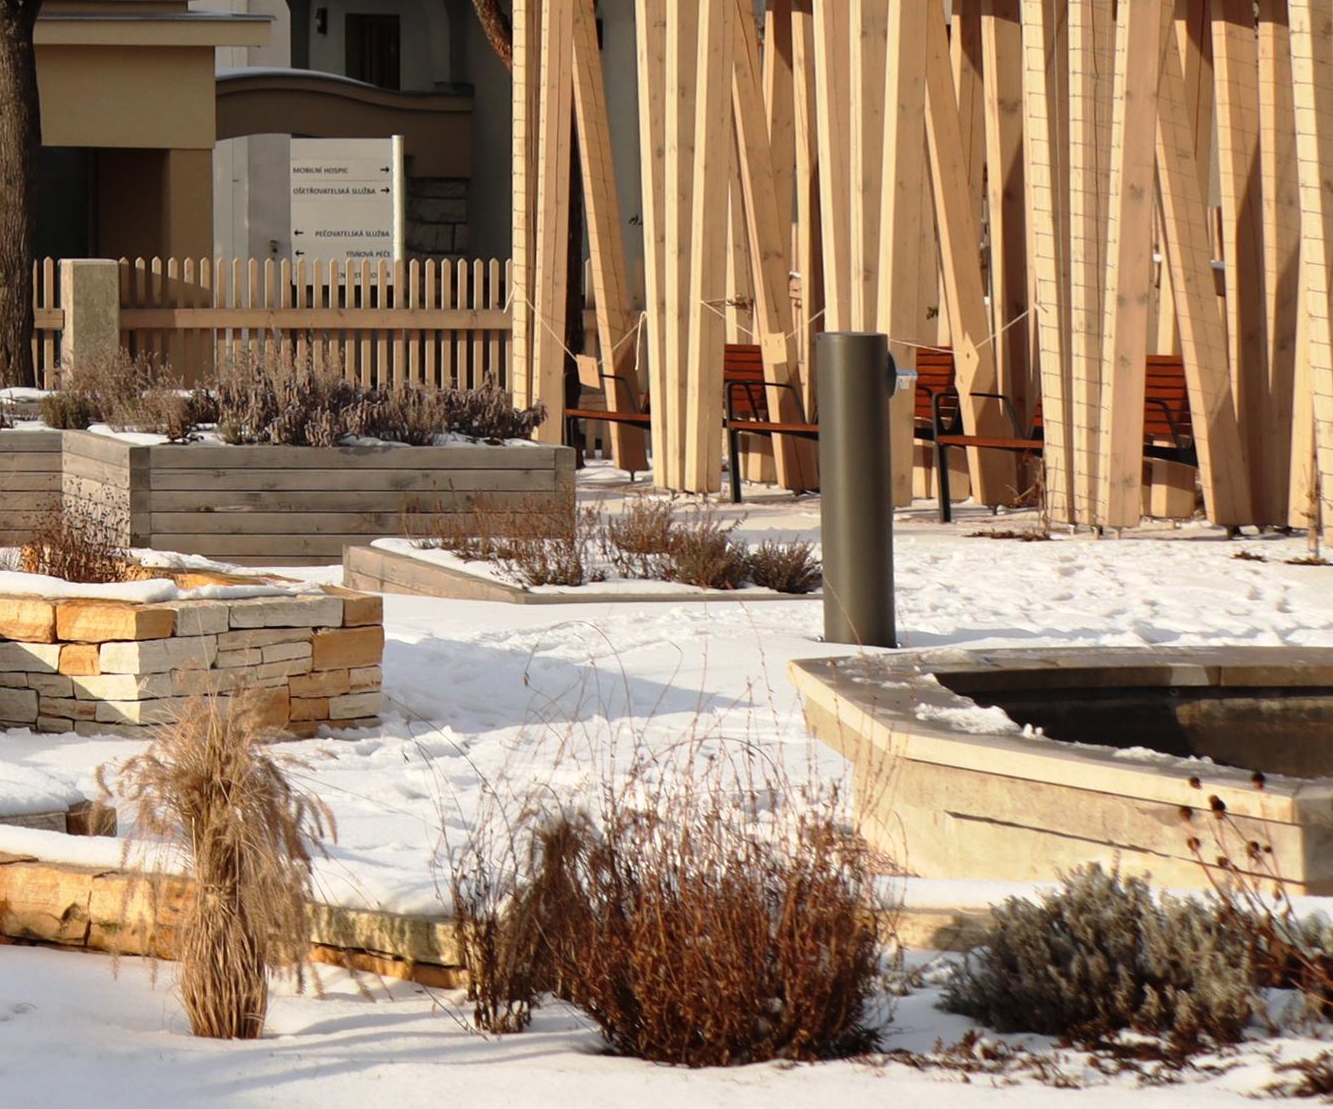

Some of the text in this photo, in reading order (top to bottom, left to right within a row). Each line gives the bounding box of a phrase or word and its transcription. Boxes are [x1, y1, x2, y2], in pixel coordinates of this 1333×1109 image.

[293, 166, 322, 174] MOBILNÍ
[293, 186, 376, 195] OŠETŘOVATELSKÁ SLUŽBA
[315, 229, 364, 237] PEČOVATELSKÁ
[346, 250, 374, 258] TÍSŇOVÁ
